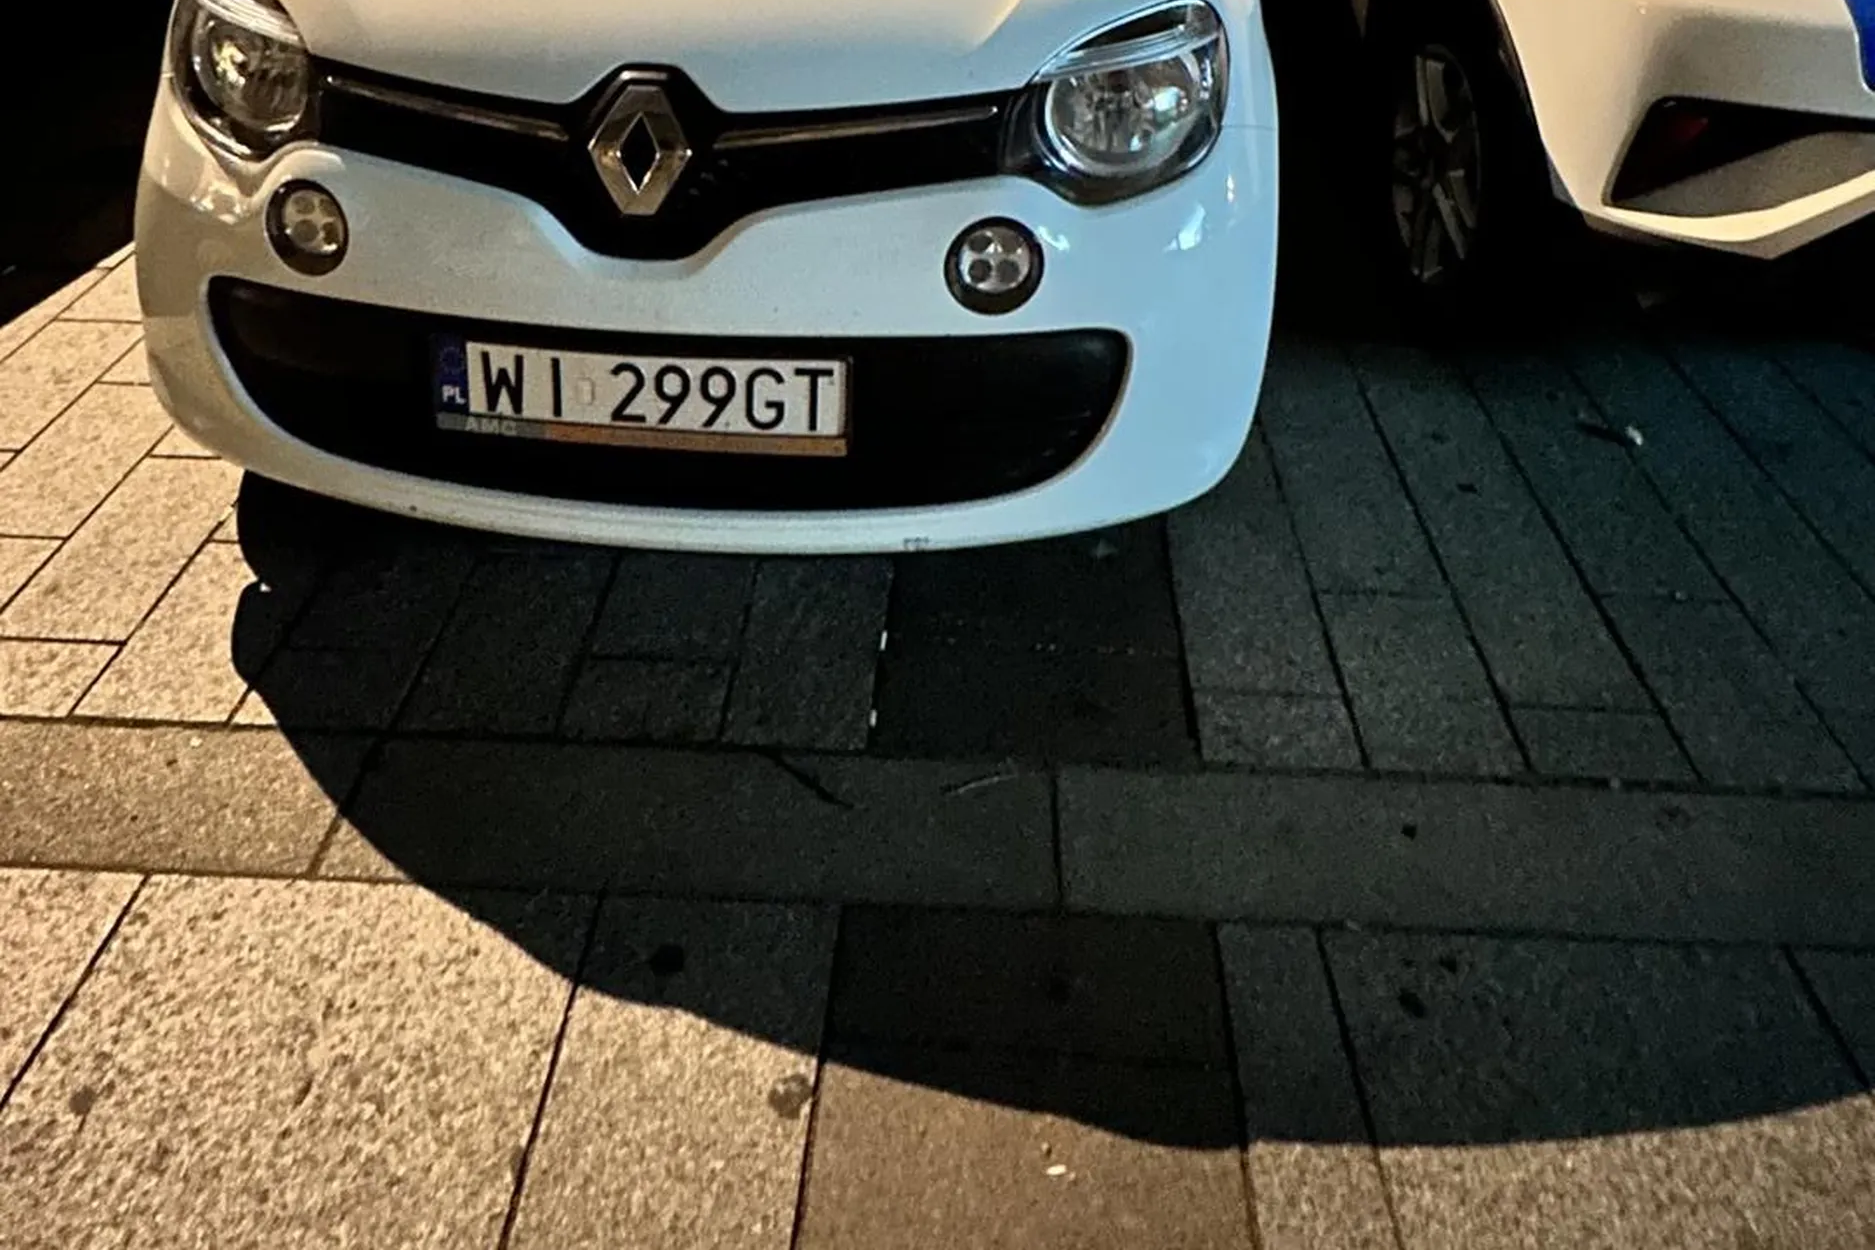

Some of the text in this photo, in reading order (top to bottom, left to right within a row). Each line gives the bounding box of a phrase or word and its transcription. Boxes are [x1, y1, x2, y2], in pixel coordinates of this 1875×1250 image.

[441, 384, 467, 406] PL
[481, 350, 834, 432] WI 299GT
